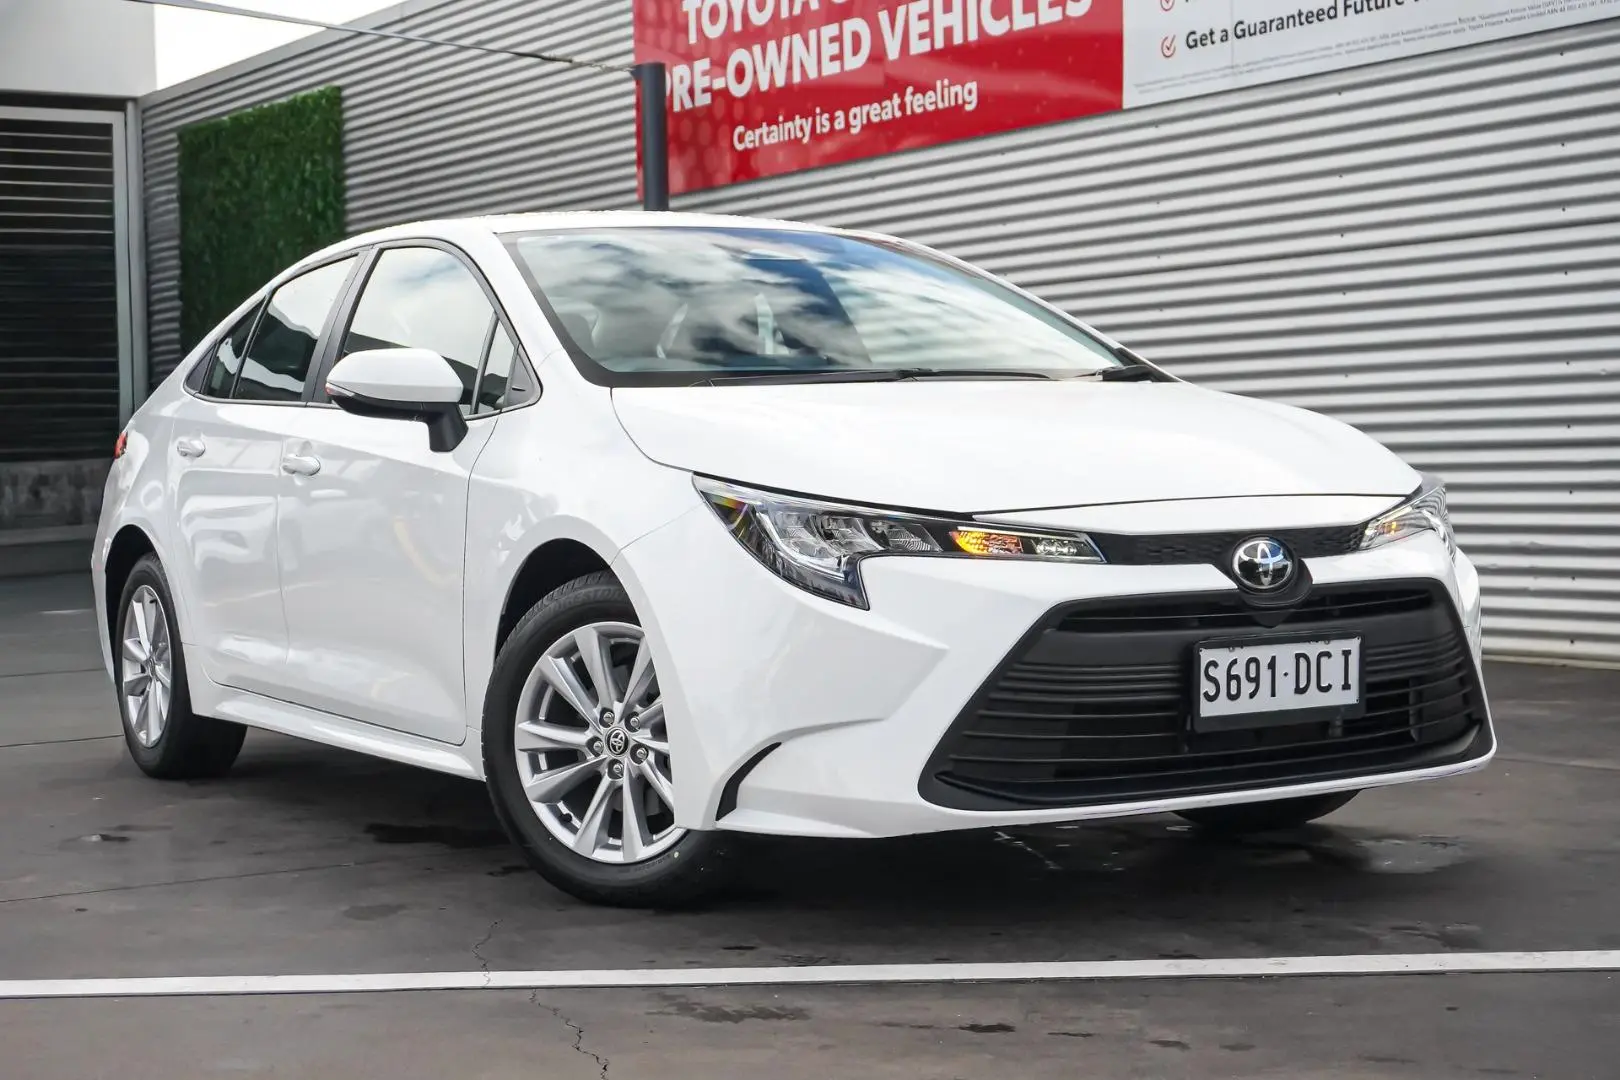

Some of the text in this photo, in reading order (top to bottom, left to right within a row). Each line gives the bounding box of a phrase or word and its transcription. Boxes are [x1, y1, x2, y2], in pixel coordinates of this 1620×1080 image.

[1185, 28, 1216, 50] Get
[1219, 28, 1229, 43] a
[1233, 0, 1338, 40] Guaranteed
[733, 78, 978, 151] Certainty is a great feeling
